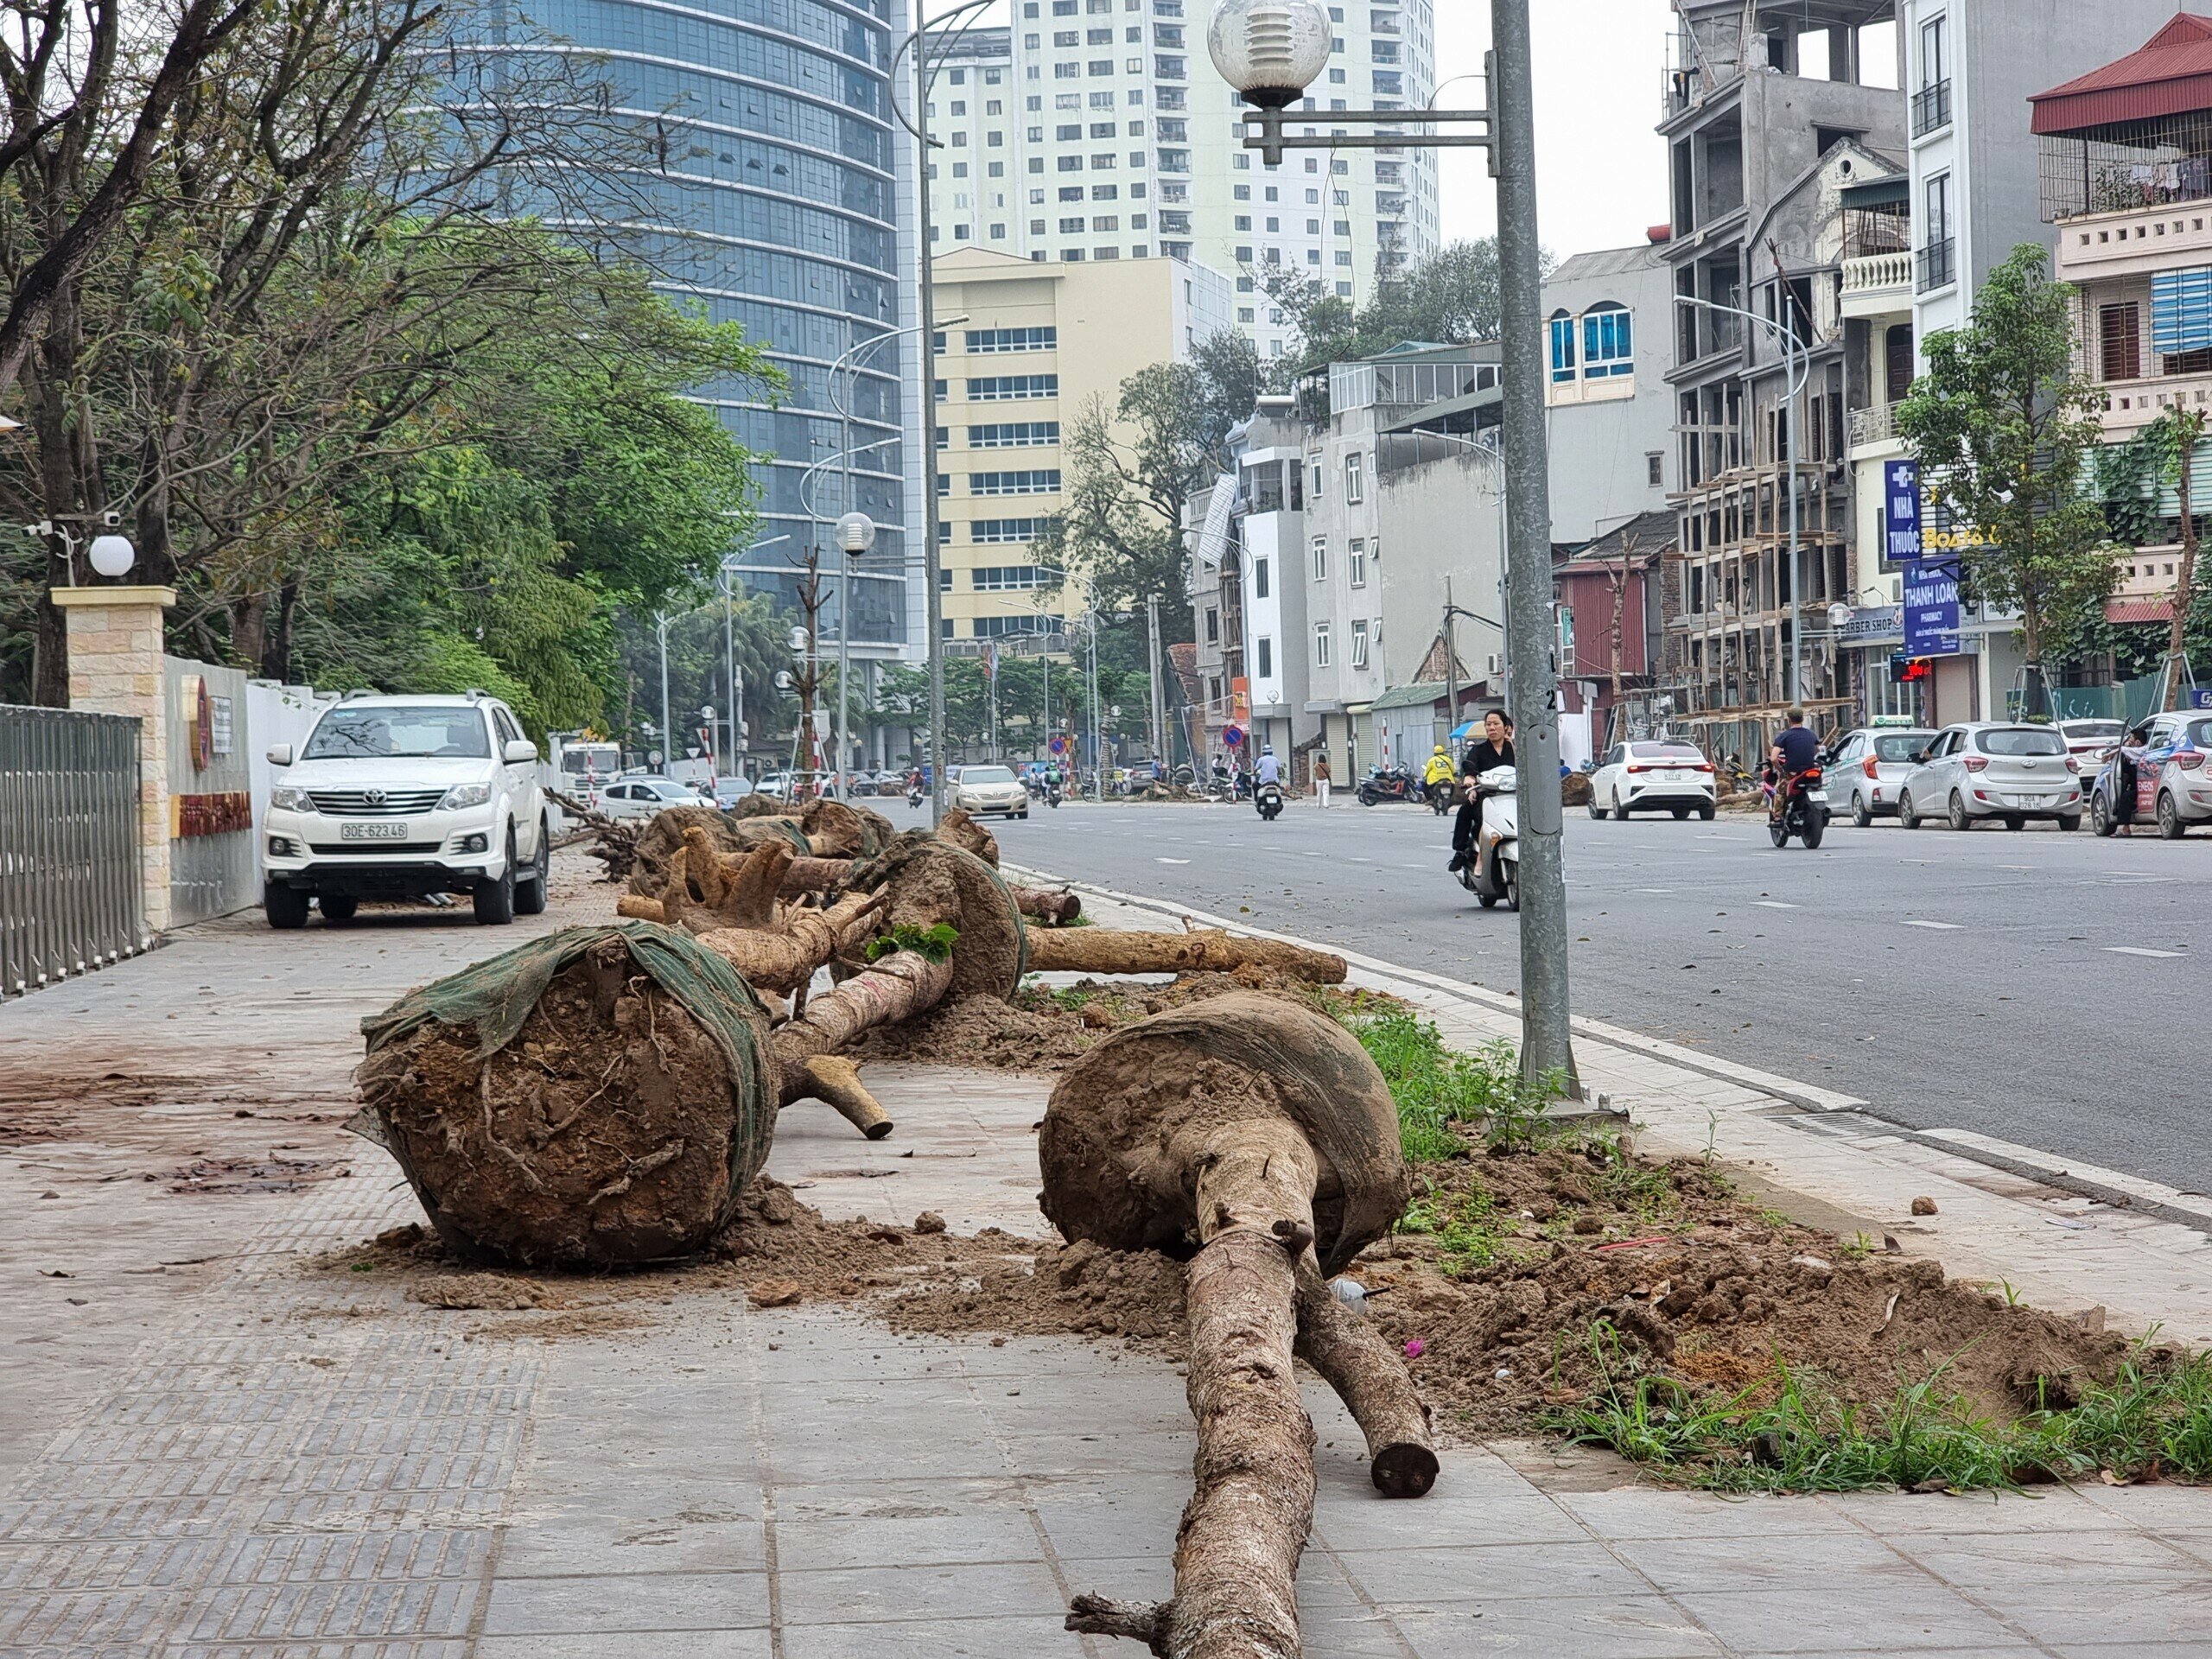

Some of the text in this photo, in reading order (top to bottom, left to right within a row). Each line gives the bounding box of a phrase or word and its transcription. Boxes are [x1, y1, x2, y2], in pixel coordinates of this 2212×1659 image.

[1893, 491, 1914, 518] NHÀ
[1889, 523, 1919, 554] THUỐC
[1904, 582, 1959, 608] THANH LOAN
[1872, 618, 1892, 632] SHOP
[1920, 610, 1942, 623] PHARMACY
[1546, 689, 1556, 710] 2
